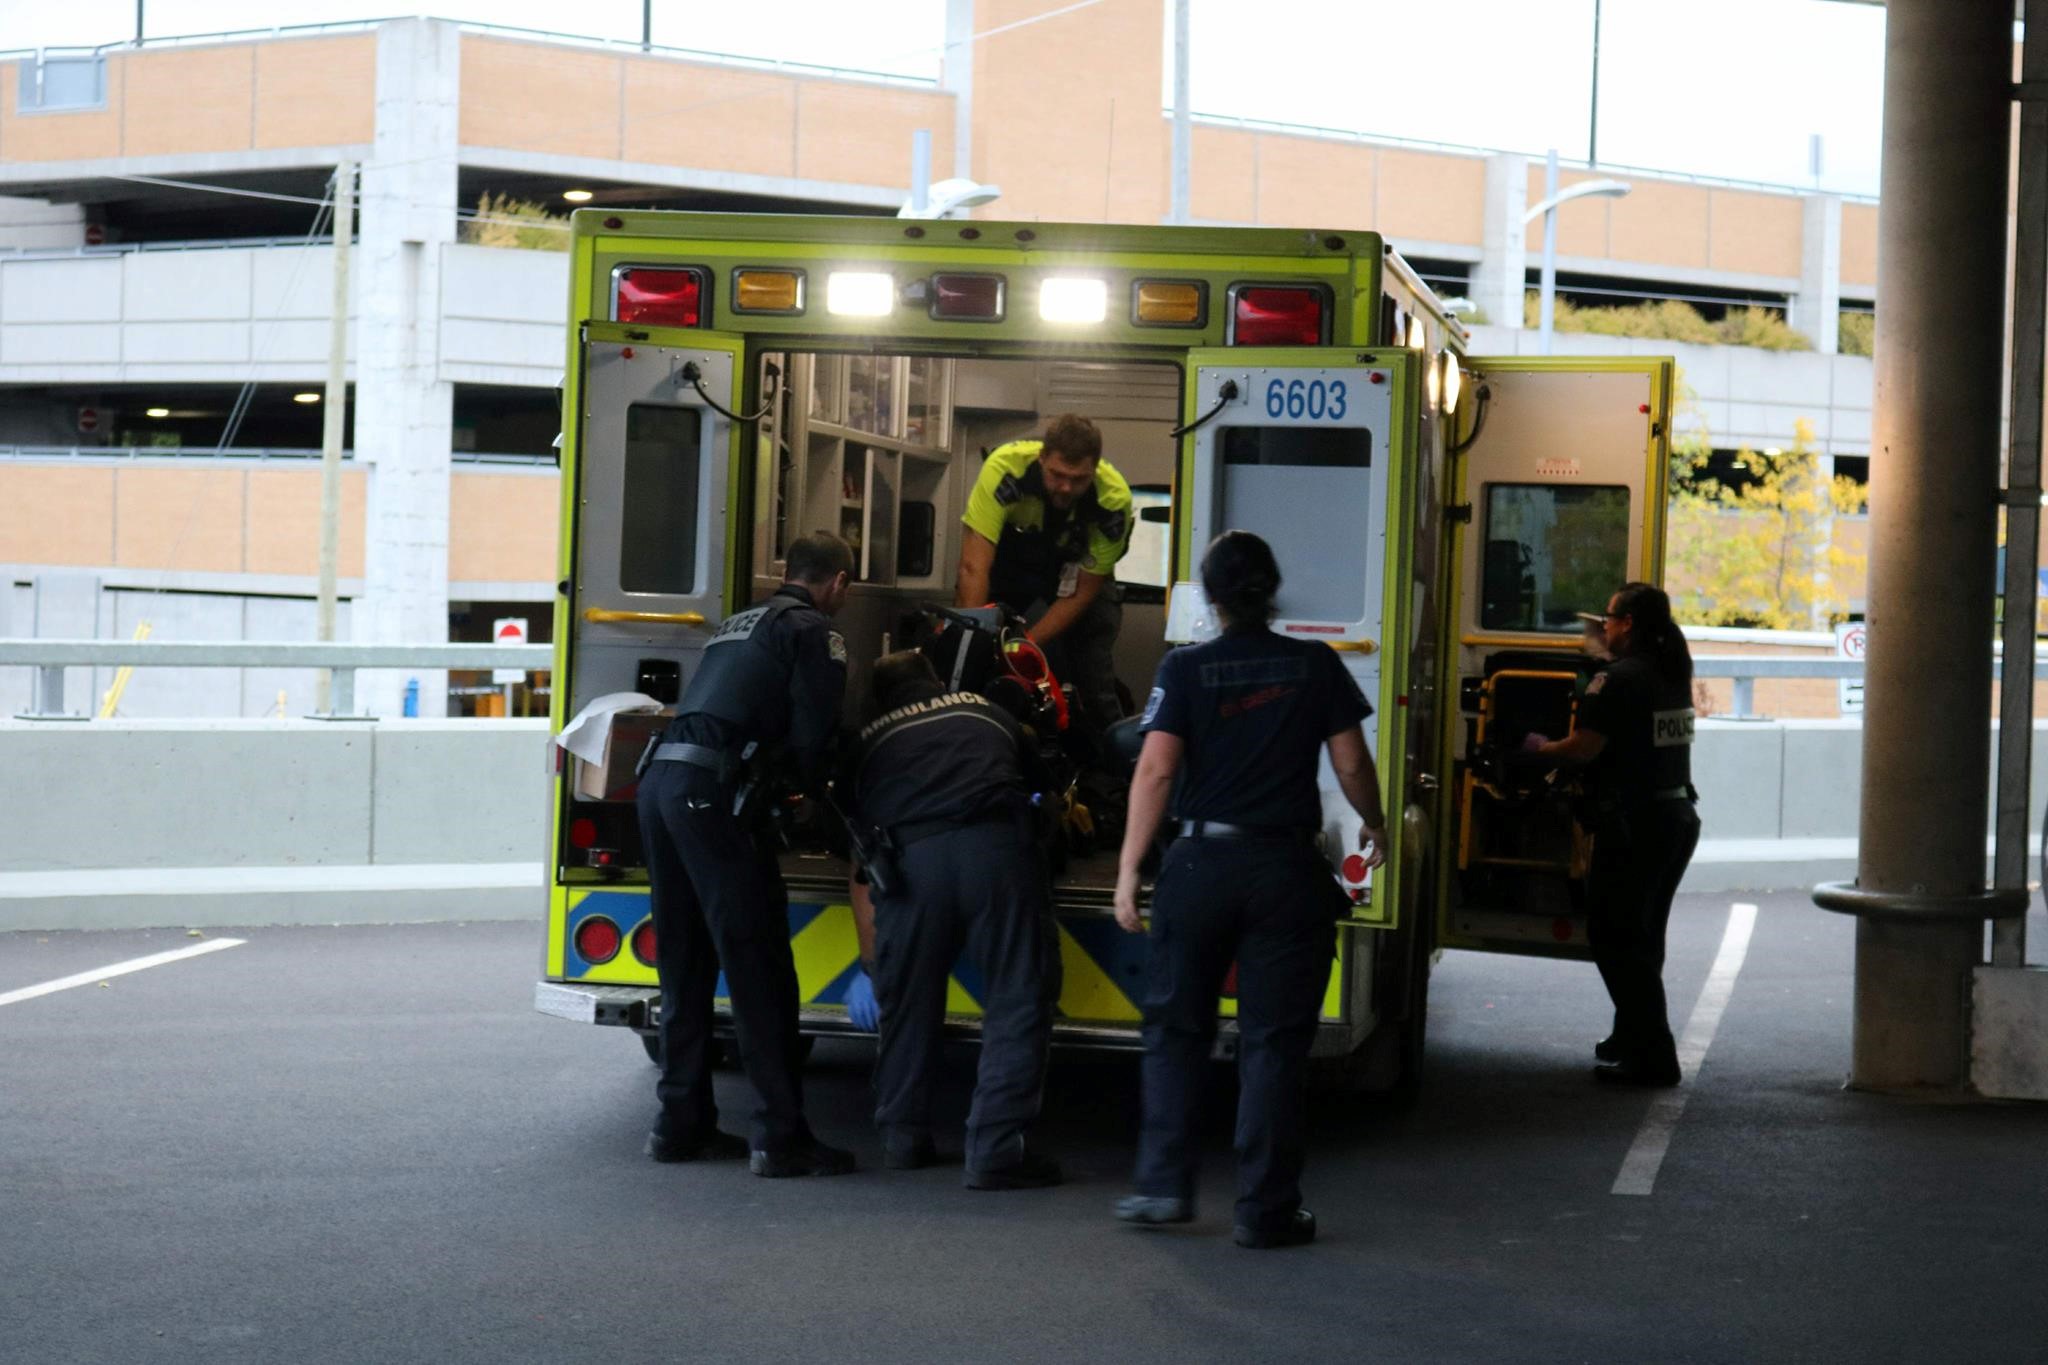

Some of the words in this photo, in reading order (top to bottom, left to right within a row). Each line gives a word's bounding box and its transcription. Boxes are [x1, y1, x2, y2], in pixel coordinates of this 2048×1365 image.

[1266, 378, 1347, 420] 6603
[861, 691, 989, 740] AMBULANCE
[1657, 716, 1695, 739] POLIC
